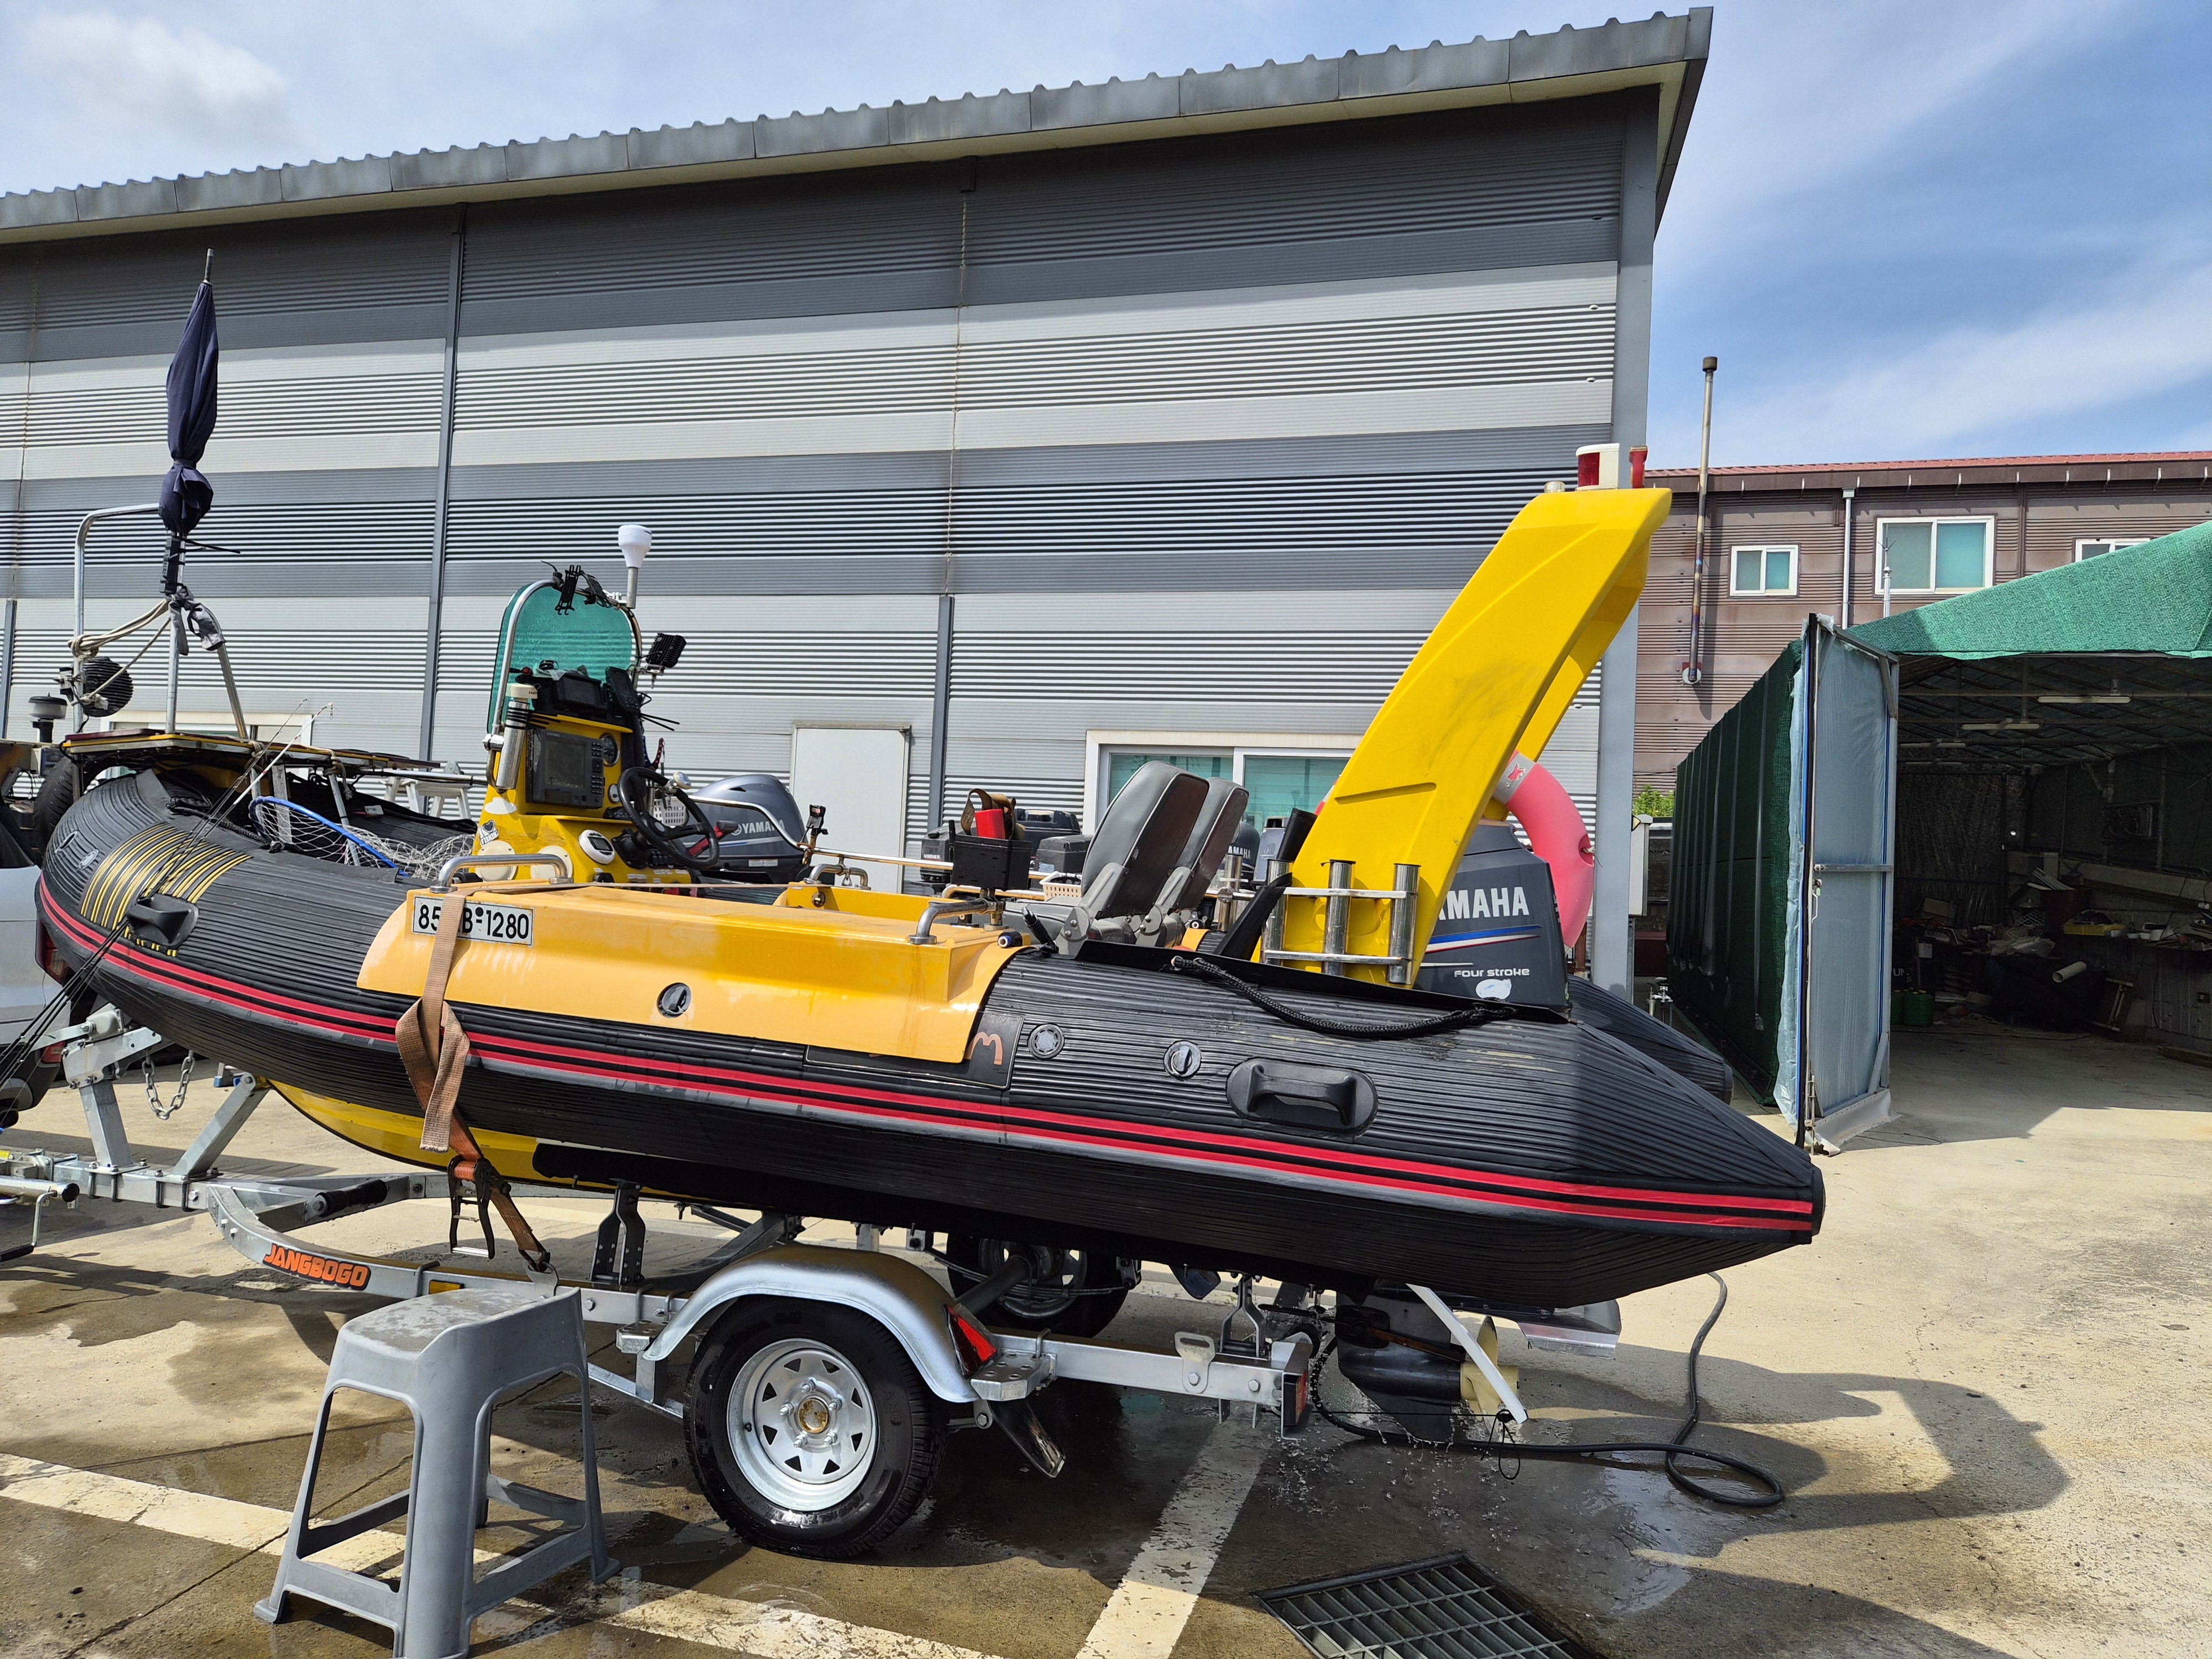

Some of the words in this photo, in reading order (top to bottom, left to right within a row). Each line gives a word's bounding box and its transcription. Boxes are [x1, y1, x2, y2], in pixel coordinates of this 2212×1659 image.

[1228, 845, 1251, 860] AMAHA
[1438, 886, 1530, 920] MAHA
[264, 1244, 369, 1287] JANGBOGO
